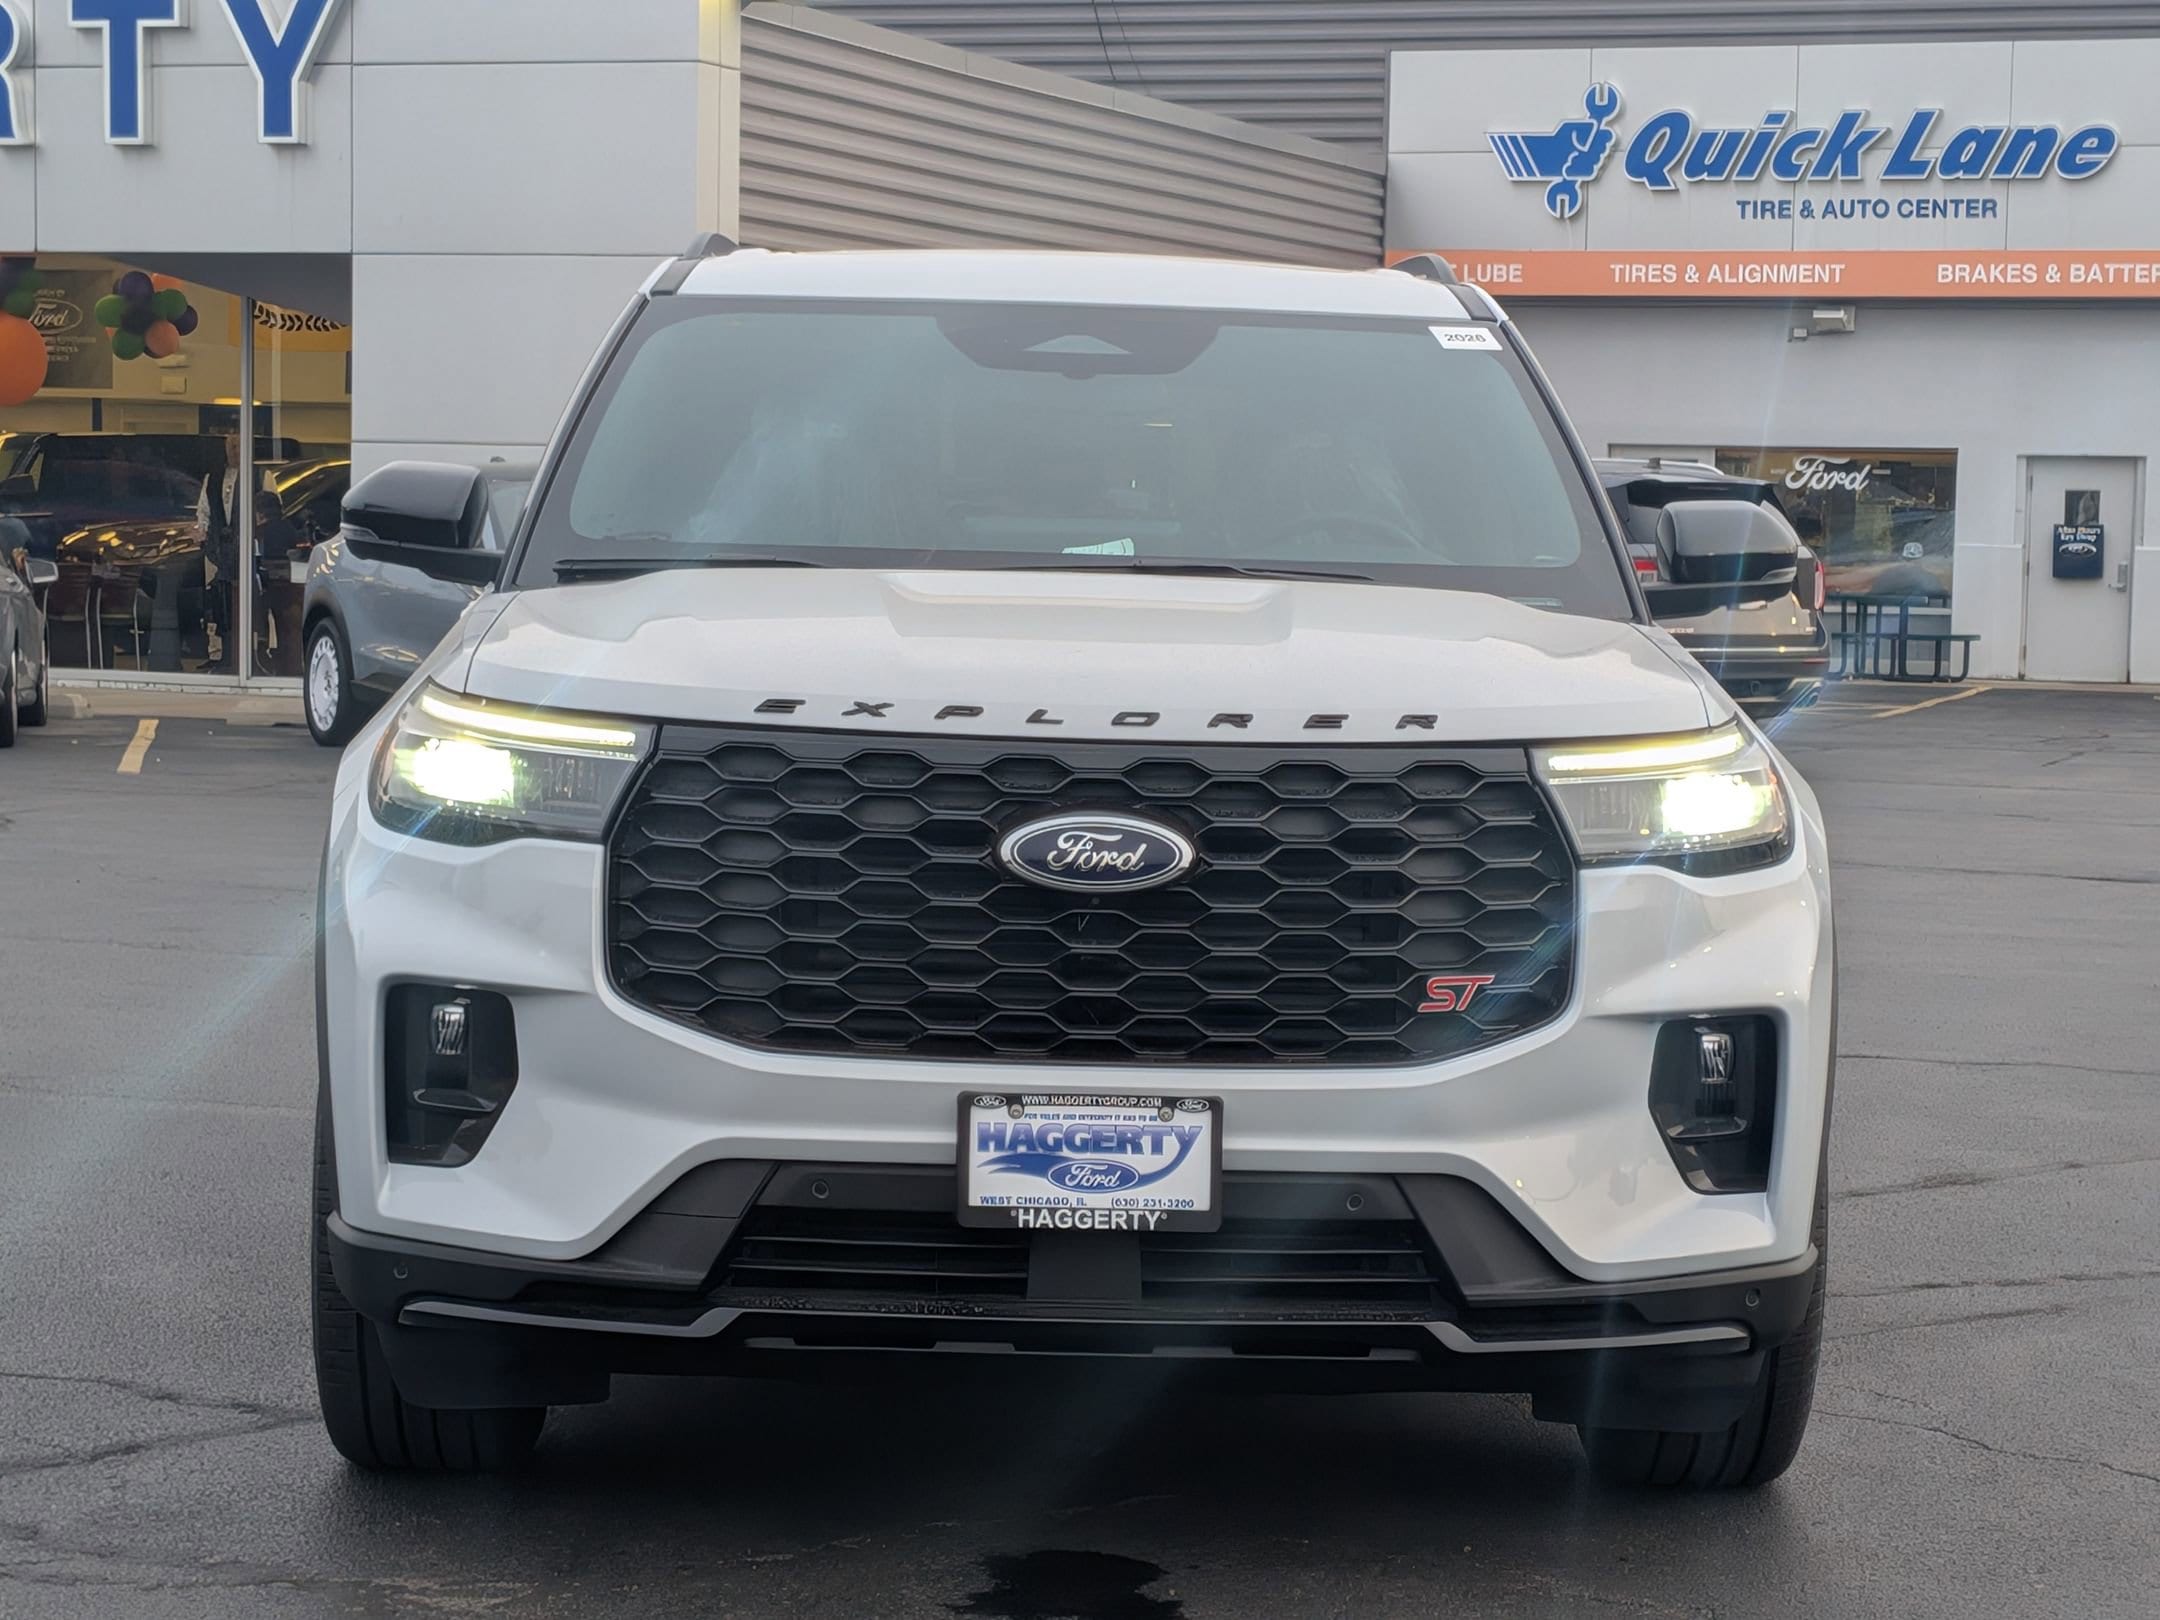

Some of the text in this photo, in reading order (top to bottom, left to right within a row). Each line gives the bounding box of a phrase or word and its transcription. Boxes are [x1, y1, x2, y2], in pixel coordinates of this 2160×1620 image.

[1624, 108, 2119, 191] Quick Lane
[1736, 198, 1998, 219] TIRE & AUTO CENTER
[1463, 263, 1523, 283] LUBE
[1610, 263, 1846, 283] TIRES & ALIGNMENT
[1937, 264, 2038, 283] BRAKES
[2045, 264, 2061, 283] &
[1785, 455, 1871, 490] Ford
[754, 698, 1438, 730] EXPLORER
[1047, 831, 1148, 872] Ford
[1417, 975, 1496, 1013] ST
[976, 1122, 1203, 1156] HAGGERTY
[1064, 1163, 1120, 1188] Ford
[980, 1196, 1012, 1206] WEST
[1111, 1197, 1140, 1208] (630)
[1017, 1208, 1161, 1231] HAGGERTY
